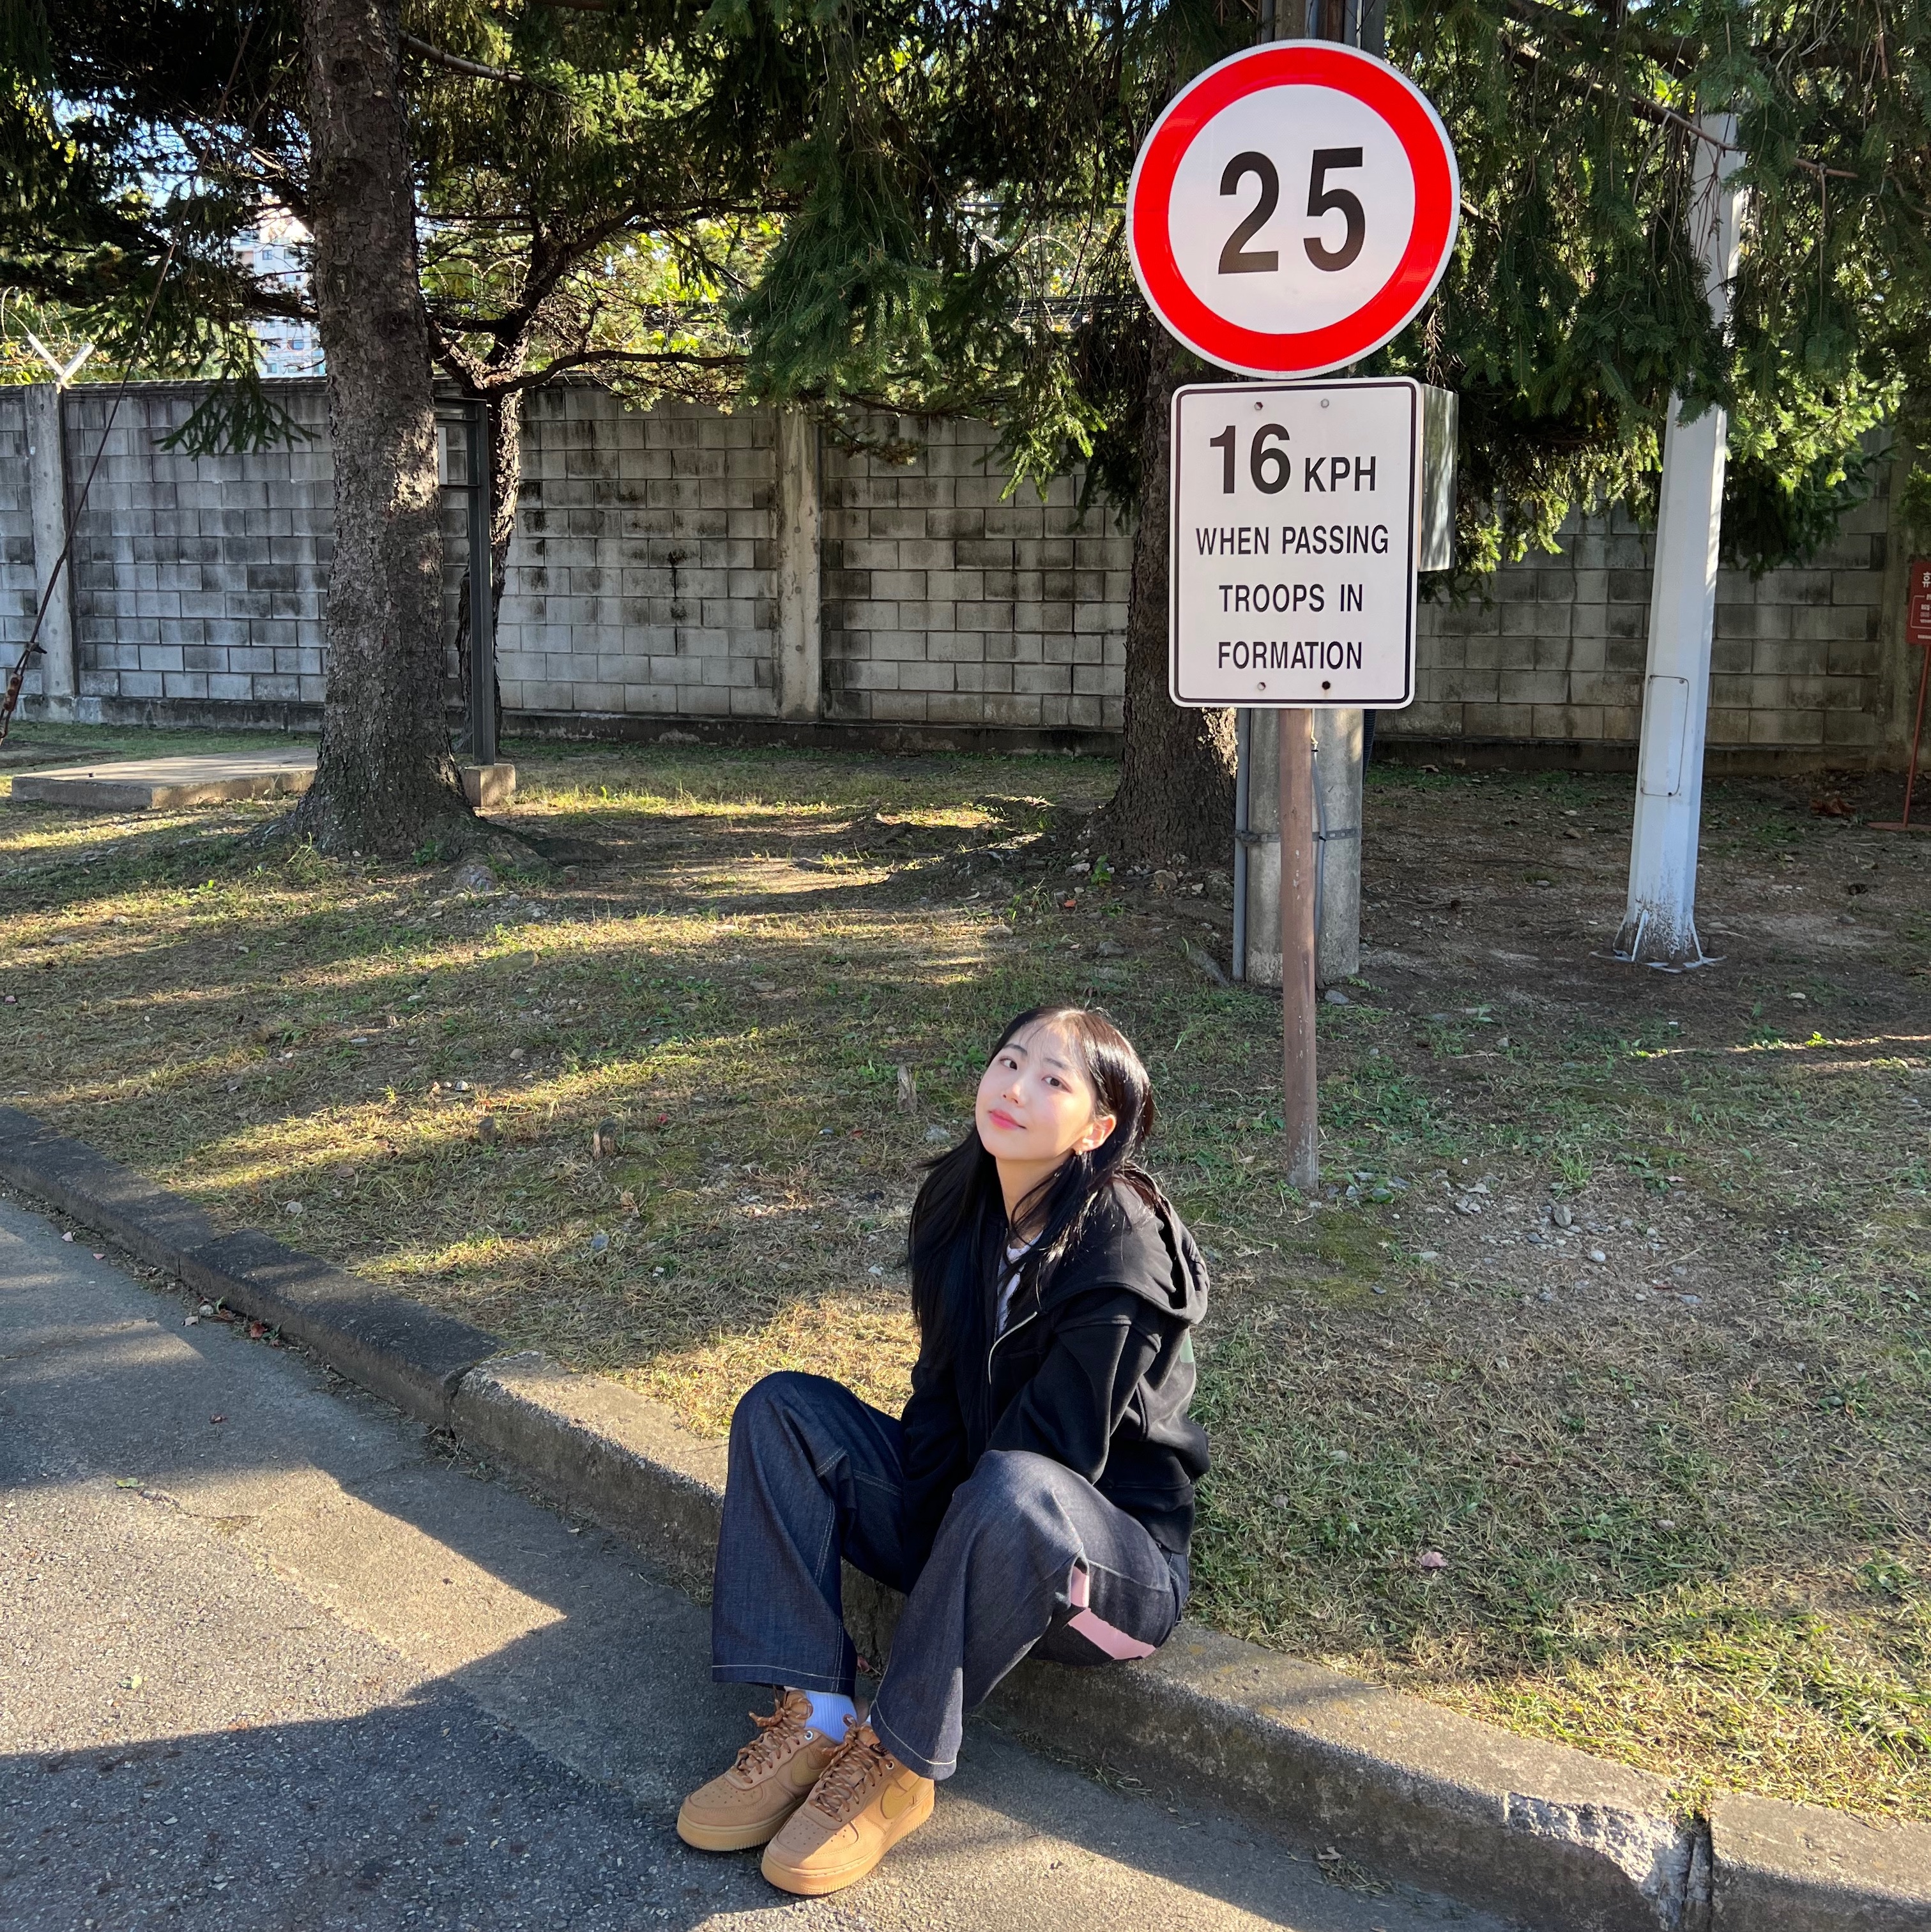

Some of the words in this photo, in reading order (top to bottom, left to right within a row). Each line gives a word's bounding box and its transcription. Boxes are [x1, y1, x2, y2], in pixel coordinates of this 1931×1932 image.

[1218, 147, 1365, 275] 25
[1210, 424, 1291, 494] 16
[1304, 456, 1376, 492] KPH
[1196, 527, 1269, 555] WHEN
[1282, 525, 1388, 554] PASSING
[1219, 584, 1325, 612] TROOPS
[1340, 584, 1362, 612] IN
[1219, 641, 1362, 669] FORMATION
